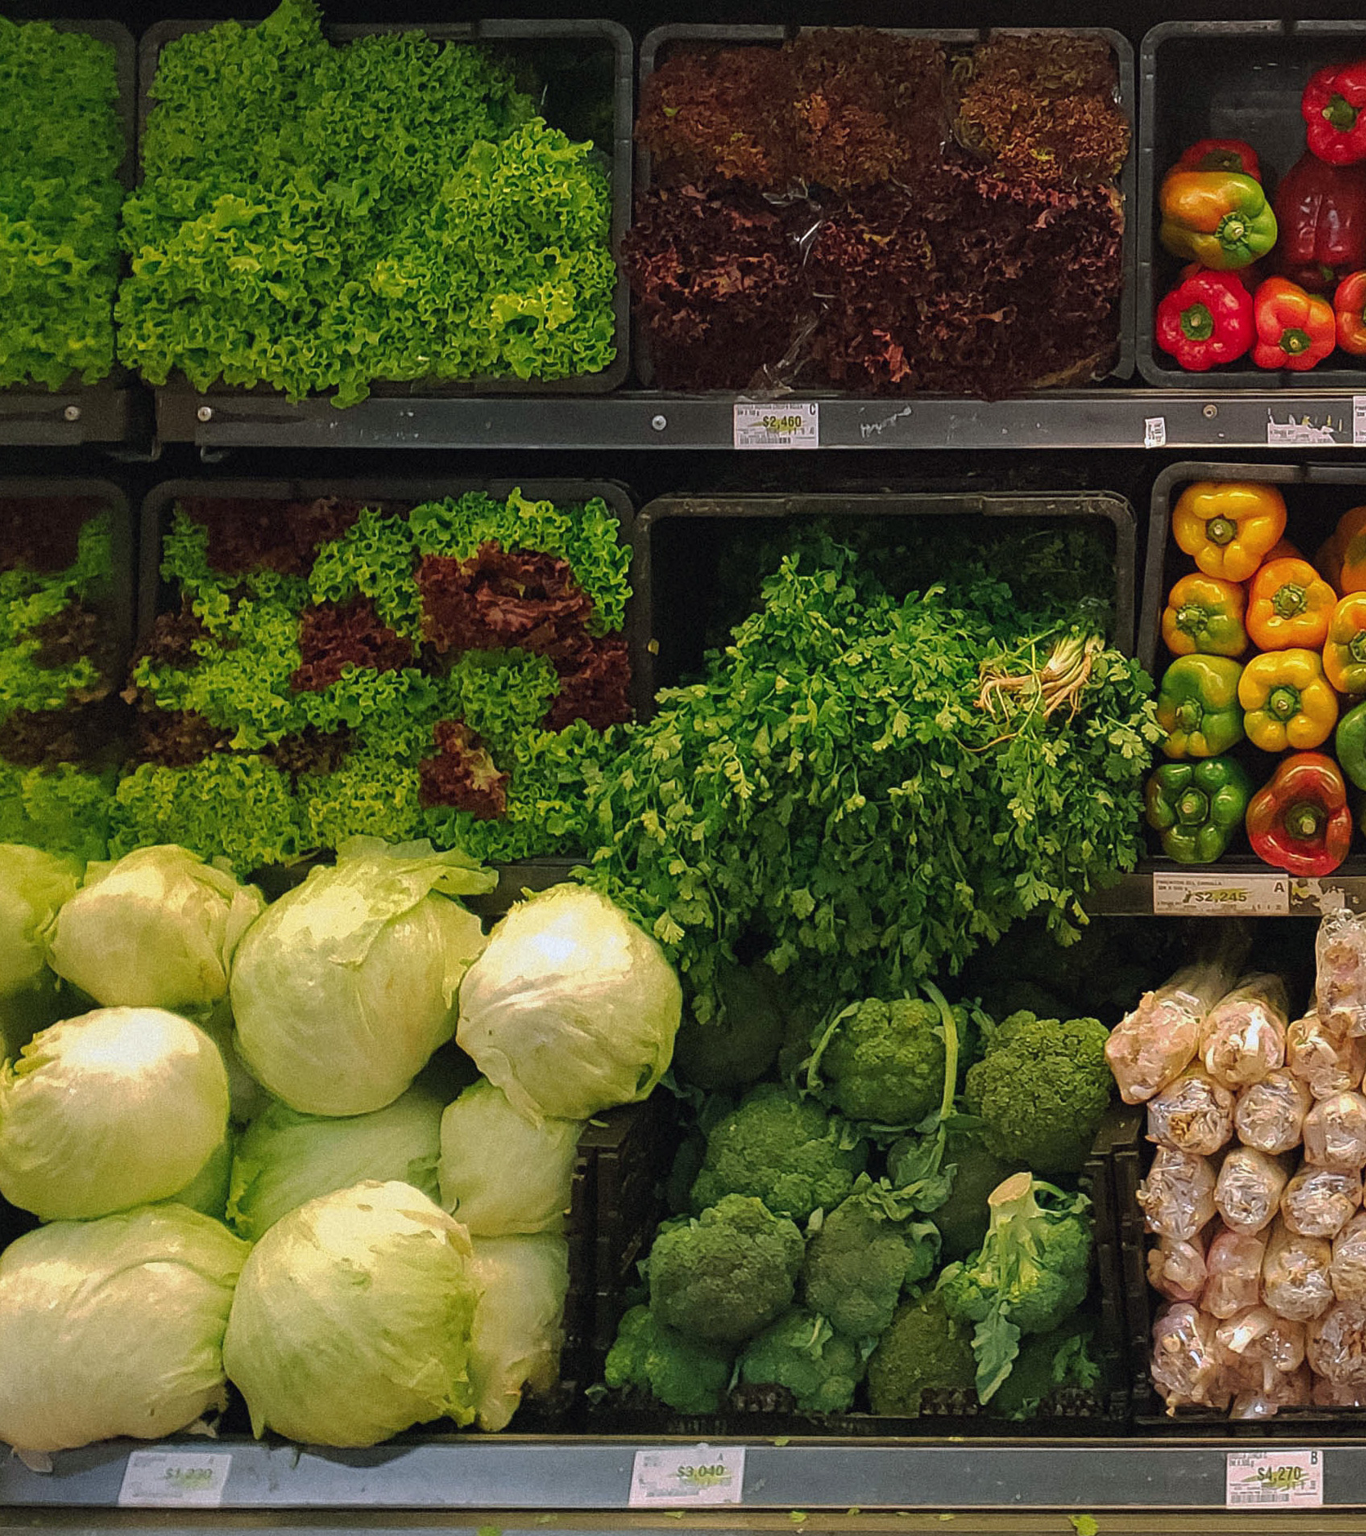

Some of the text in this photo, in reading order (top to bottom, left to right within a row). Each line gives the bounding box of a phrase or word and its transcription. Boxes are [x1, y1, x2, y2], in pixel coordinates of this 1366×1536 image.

[809, 403, 816, 415] C
[762, 416, 802, 430] $2,460
[1273, 882, 1285, 893] A
[1195, 891, 1247, 904] $2,245
[1311, 1451, 1318, 1465] B
[676, 1464, 725, 1479] $3,040
[1257, 1466, 1301, 1482] $4,270
